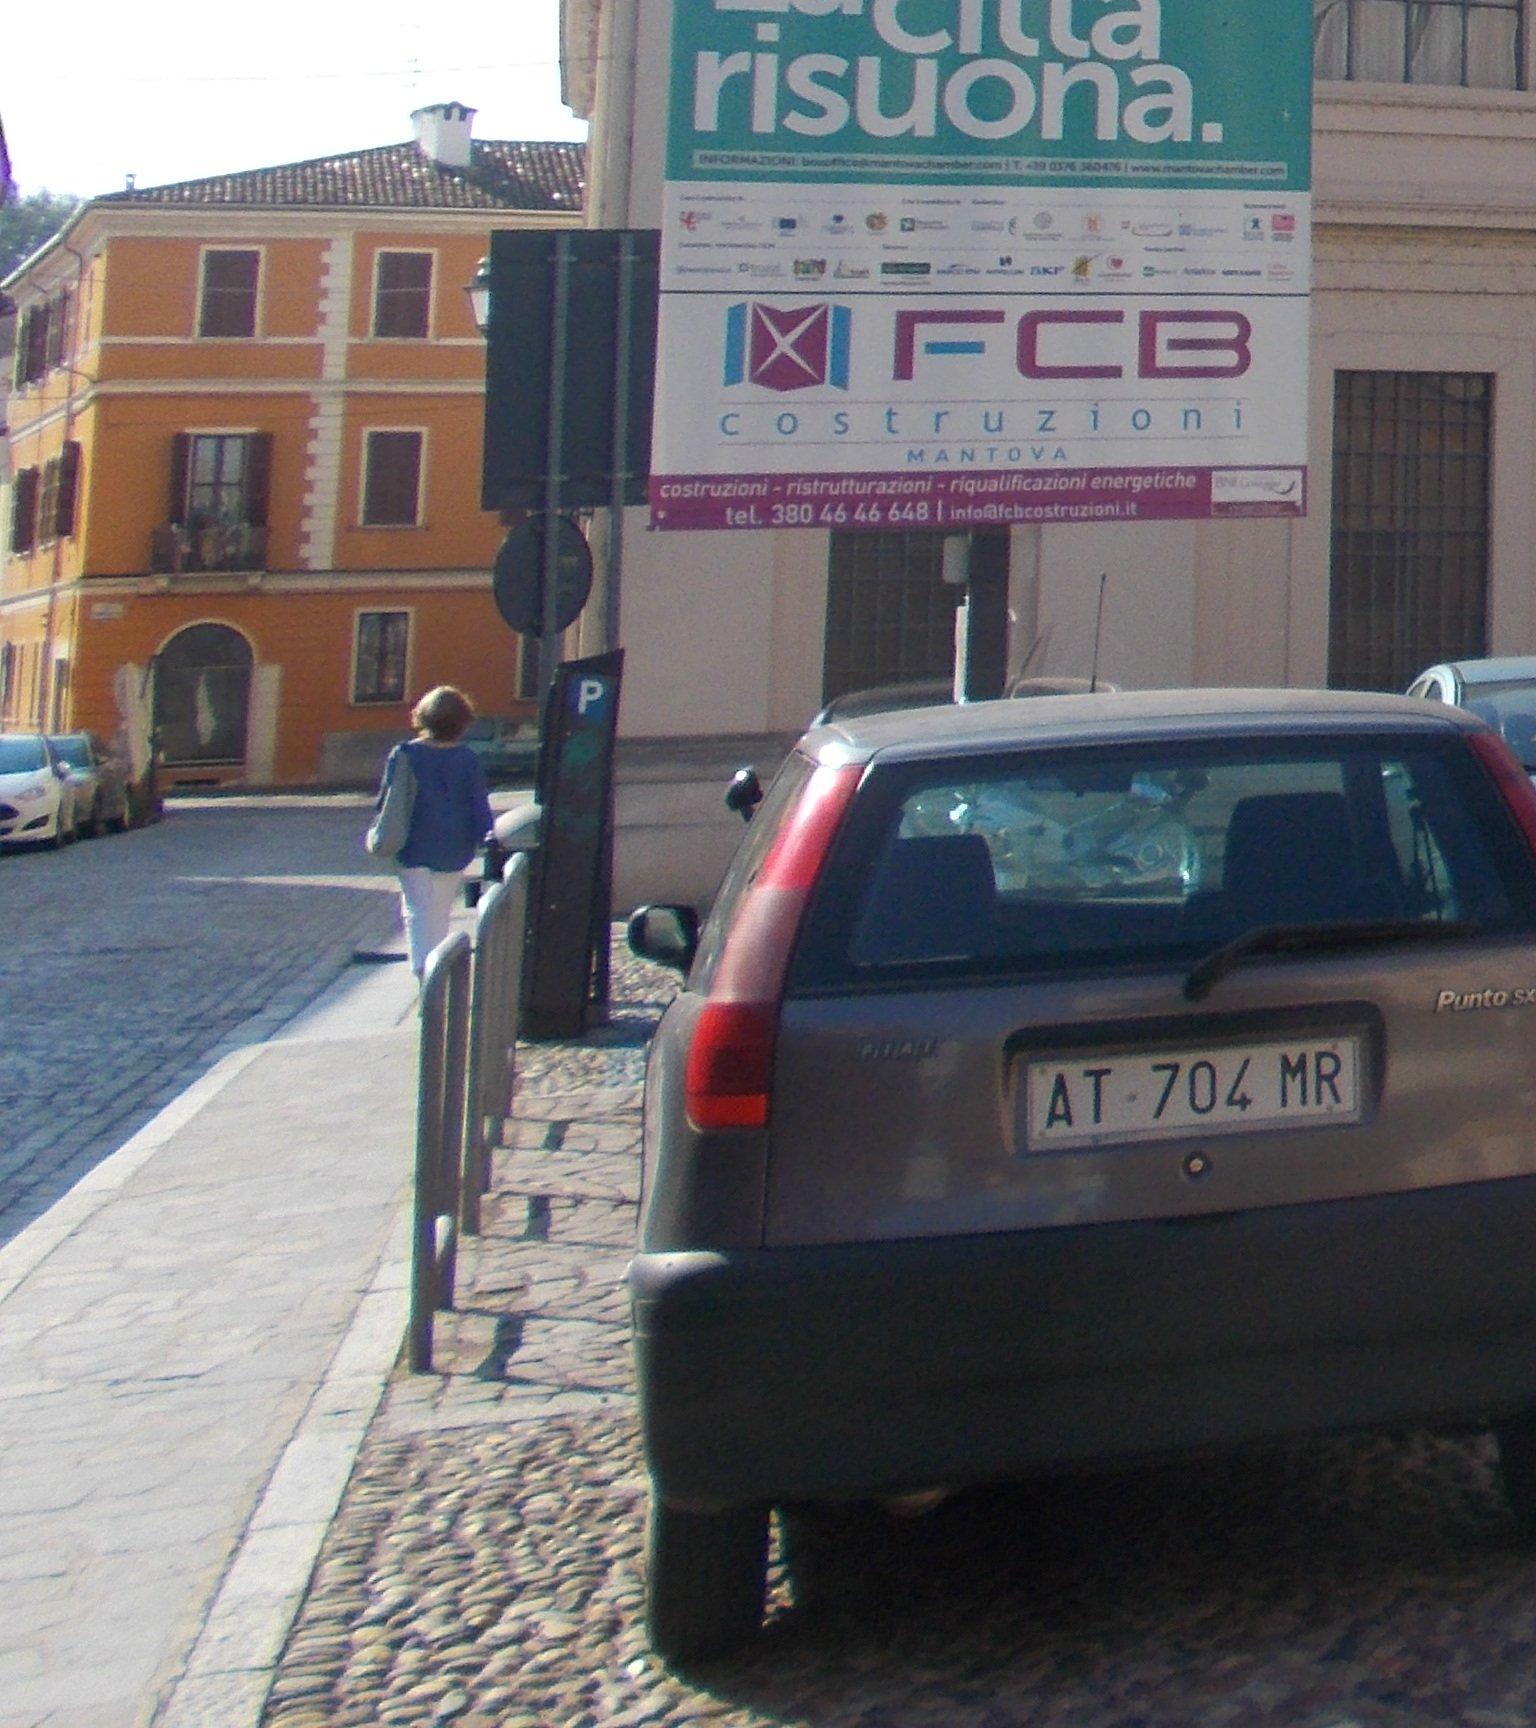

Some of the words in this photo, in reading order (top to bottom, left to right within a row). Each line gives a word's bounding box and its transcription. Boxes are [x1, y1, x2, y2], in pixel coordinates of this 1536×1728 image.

[693, 22, 1224, 144] risuona.
[893, 309, 1252, 381] FCB
[719, 403, 1243, 436] costruzioni
[907, 446, 1069, 464] MANTOVA
[659, 478, 769, 498] costruzioni
[786, 475, 931, 496] ristrutturazioni
[950, 472, 1086, 495] riqualificazioni
[1091, 471, 1197, 491] energetiche
[725, 505, 762, 525] tel.
[771, 504, 813, 523] 380
[819, 503, 846, 523] 46
[854, 502, 881, 522] 46
[888, 501, 930, 521] 648
[951, 501, 1138, 521] info@fcbcostruzioni.it
[578, 679, 604, 714] P
[1434, 986, 1508, 1014] Punto
[1511, 986, 1536, 1007] SX
